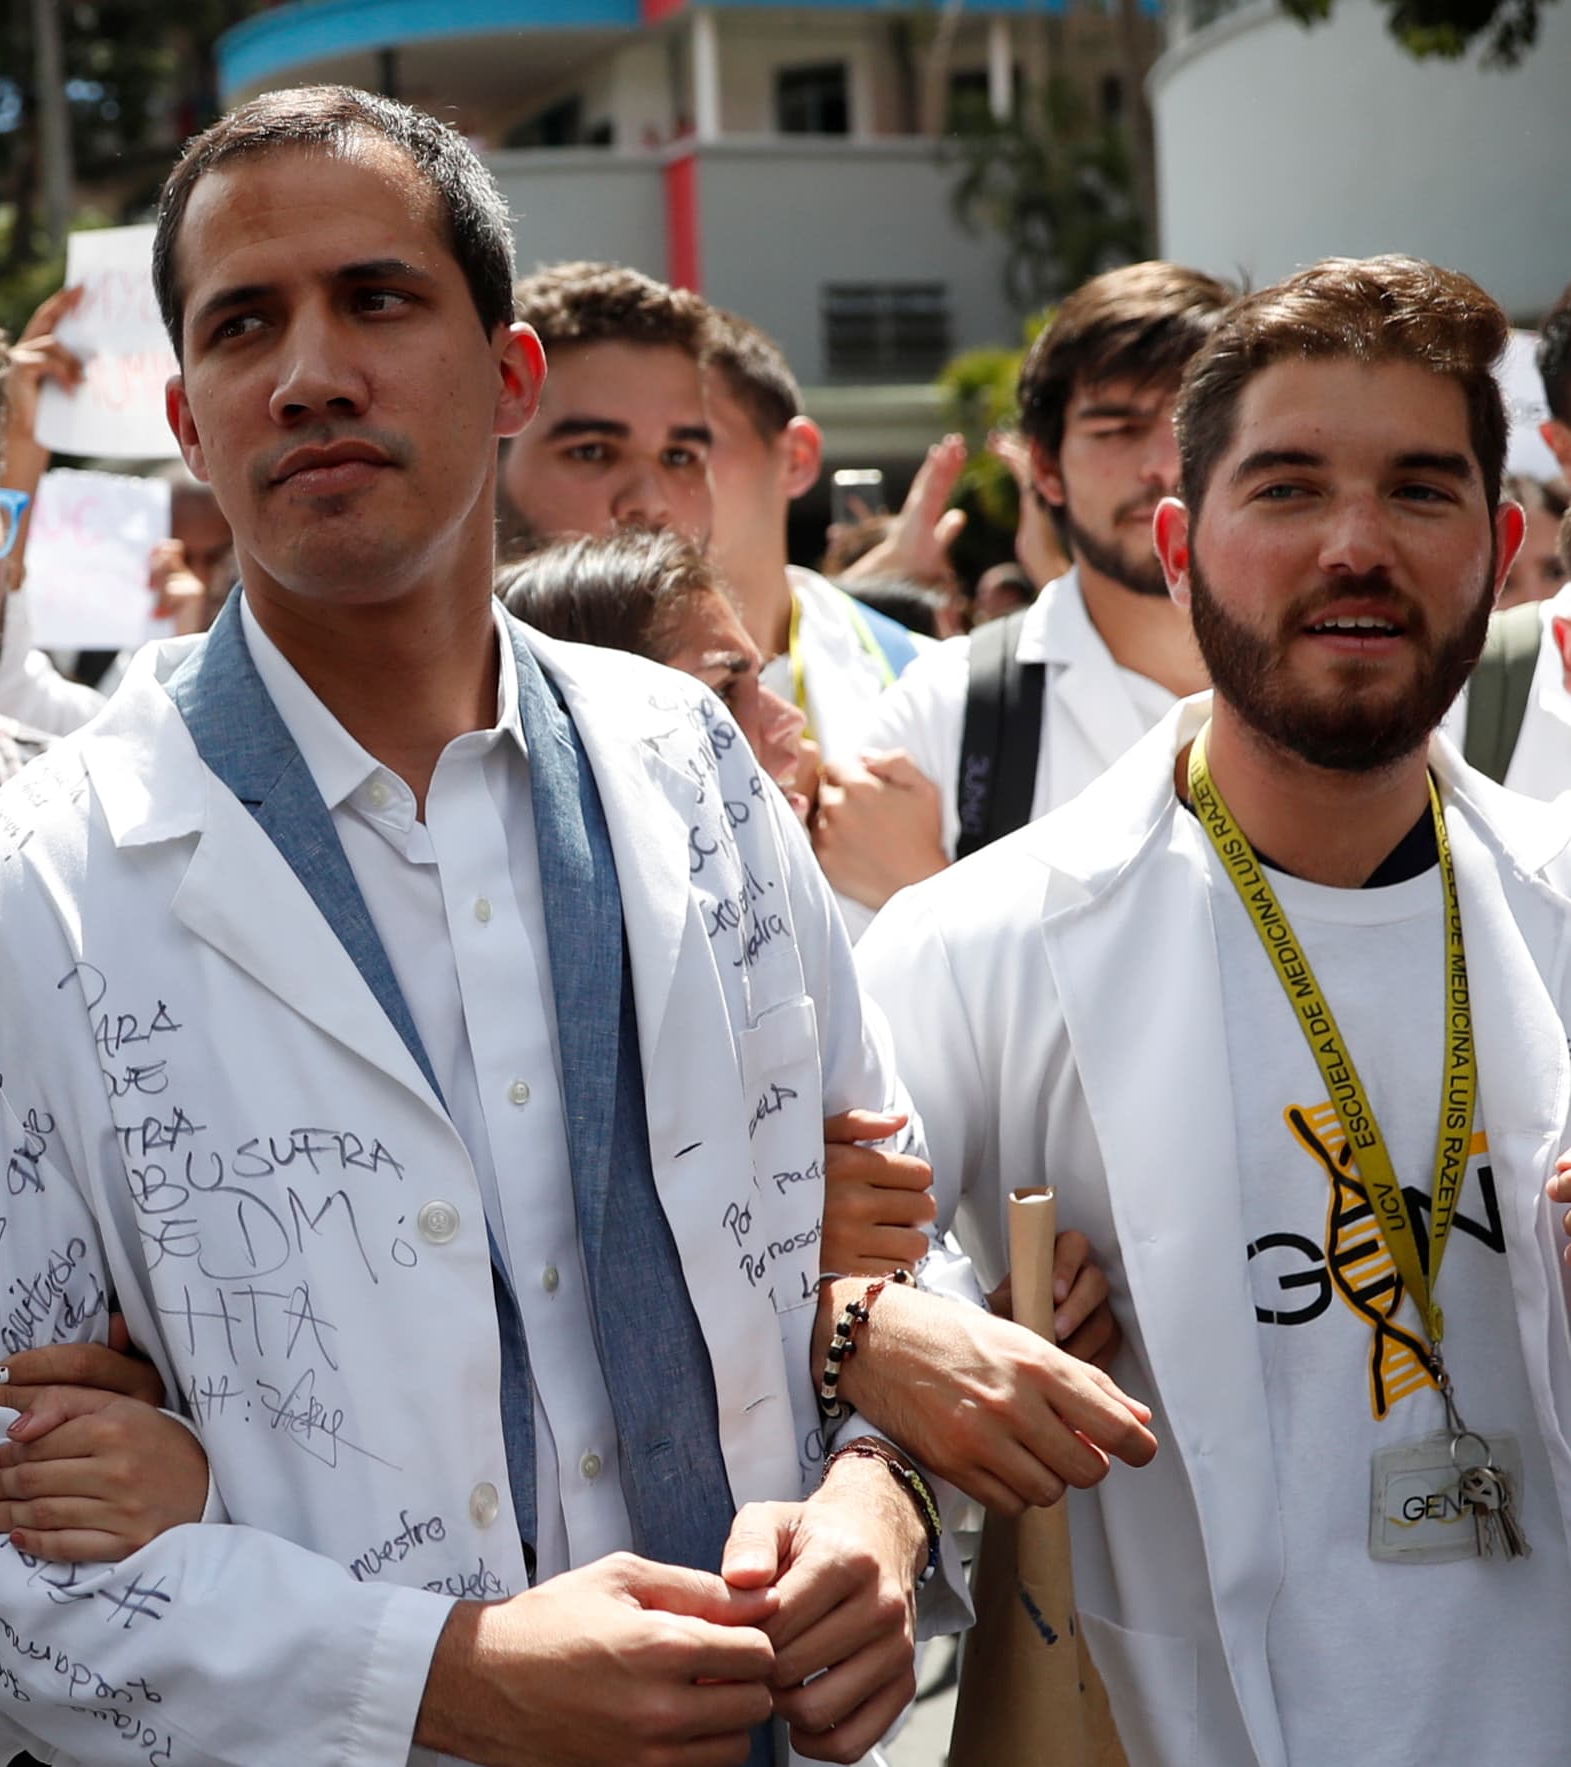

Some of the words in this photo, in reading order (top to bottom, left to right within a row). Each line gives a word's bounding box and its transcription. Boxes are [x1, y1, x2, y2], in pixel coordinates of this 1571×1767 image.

[1190, 760, 1232, 838] RAZETTI
[1222, 838, 1261, 887] LUIS
[1250, 887, 1314, 998] MEDICINA
[1302, 1001, 1331, 1037] DE
[1449, 953, 1471, 1069] MEDICINA
[1319, 1038, 1377, 1149] ESCUELA
[1446, 1075, 1470, 1130] LUIS
[1373, 1182, 1405, 1232] UCV
[1434, 1136, 1464, 1239] RAZETTI
